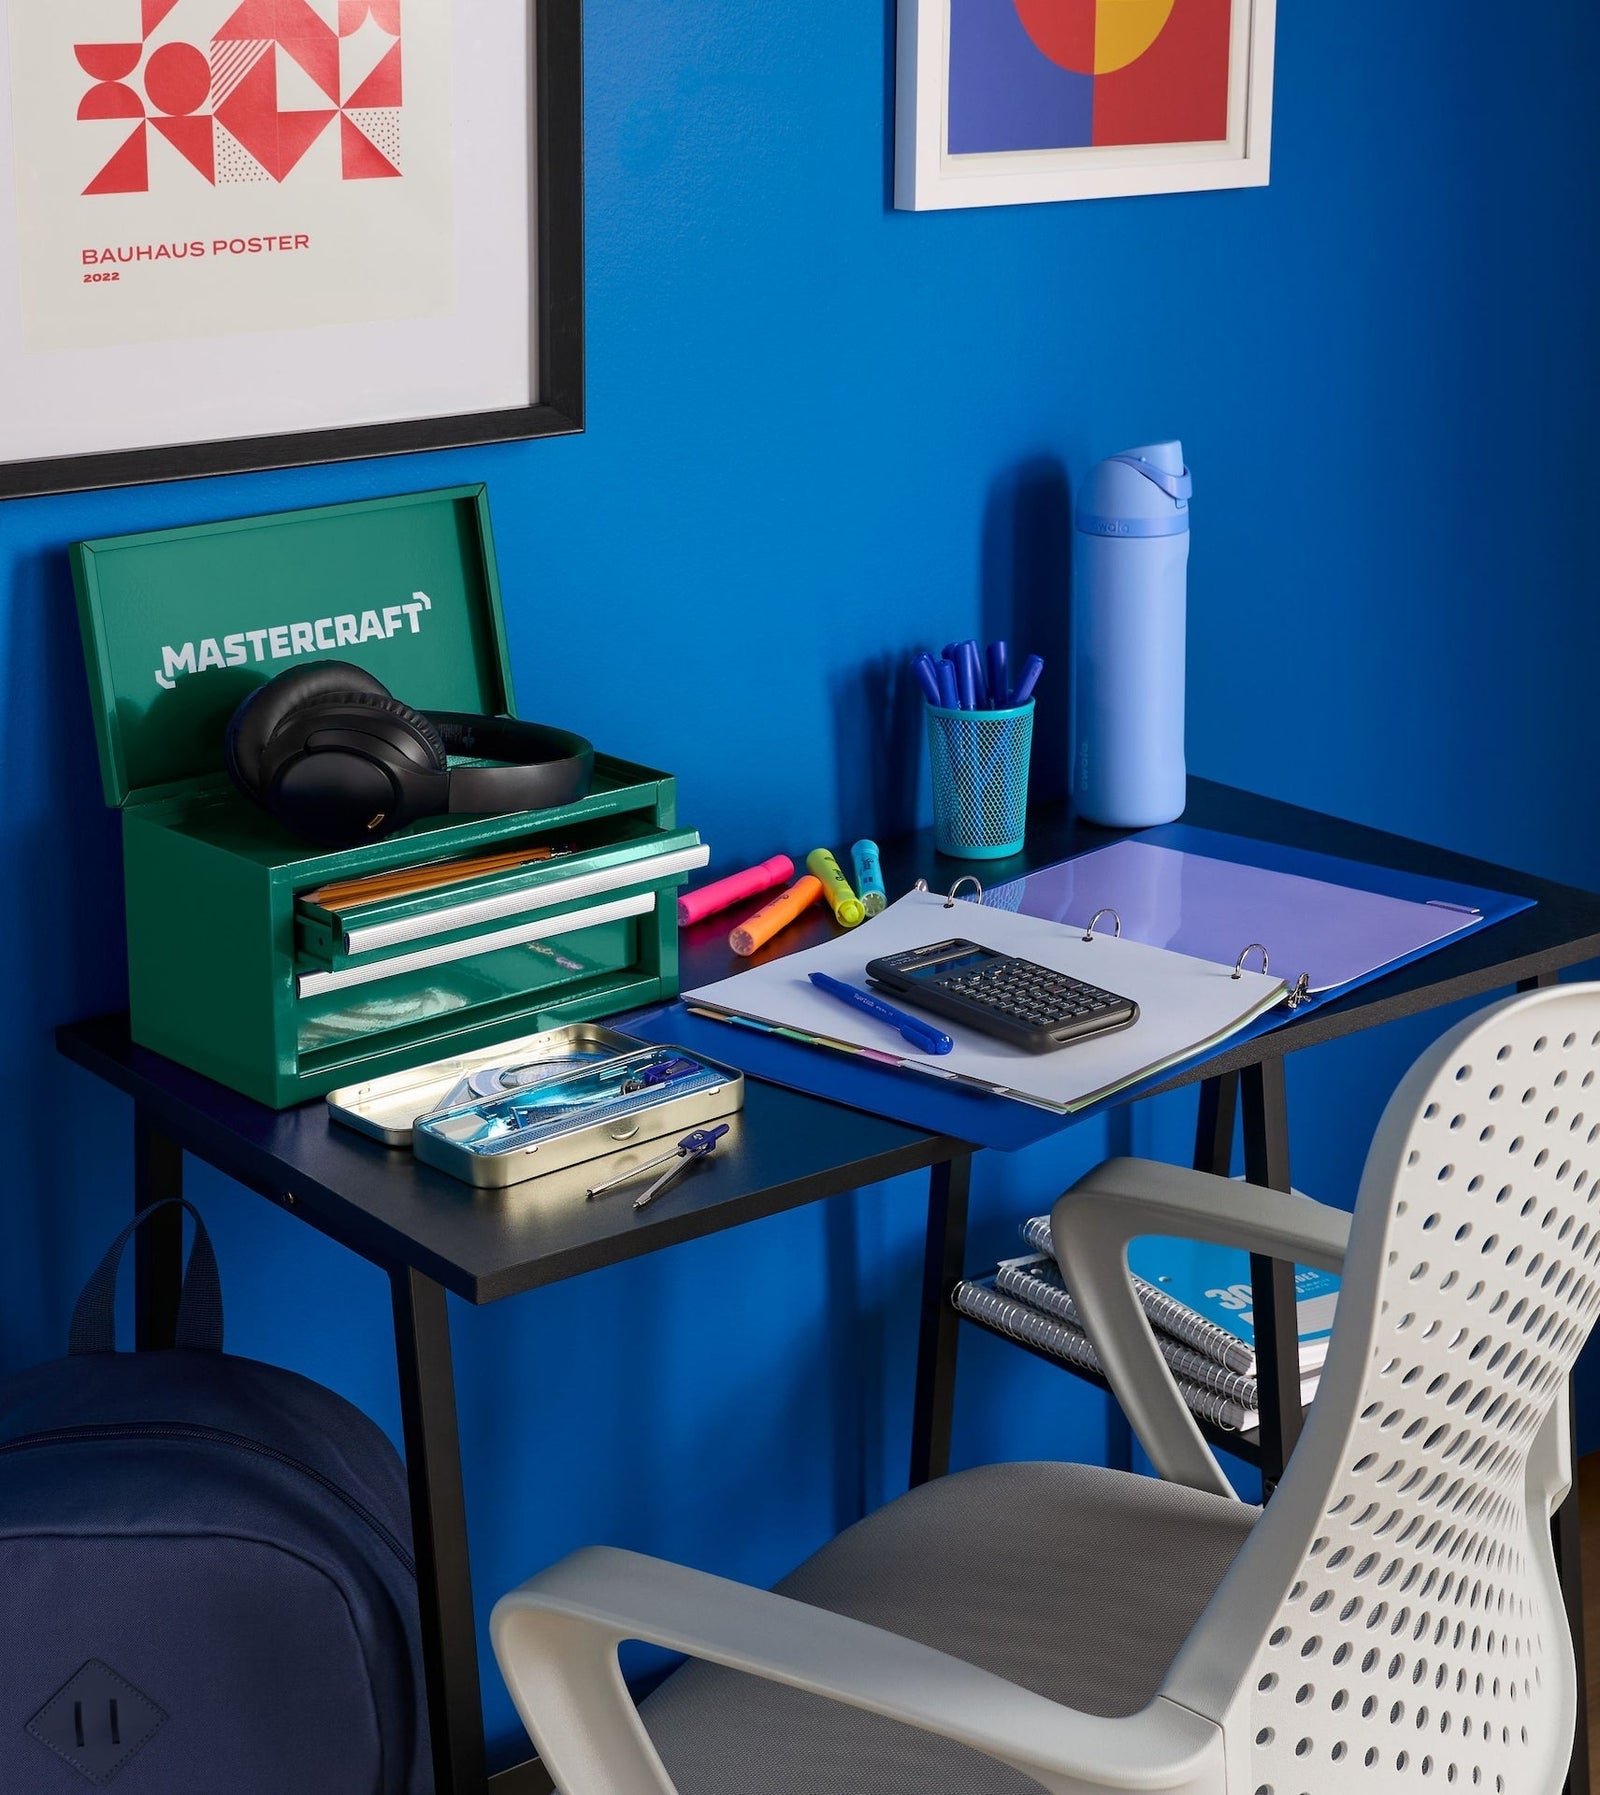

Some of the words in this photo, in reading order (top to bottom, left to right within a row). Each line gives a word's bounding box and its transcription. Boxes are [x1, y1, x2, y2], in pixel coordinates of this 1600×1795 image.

[82, 241, 206, 265] BAUHAUS
[212, 234, 310, 256] POSTER
[83, 272, 120, 283] 2022
[160, 602, 423, 678] MASTERCRAFT
